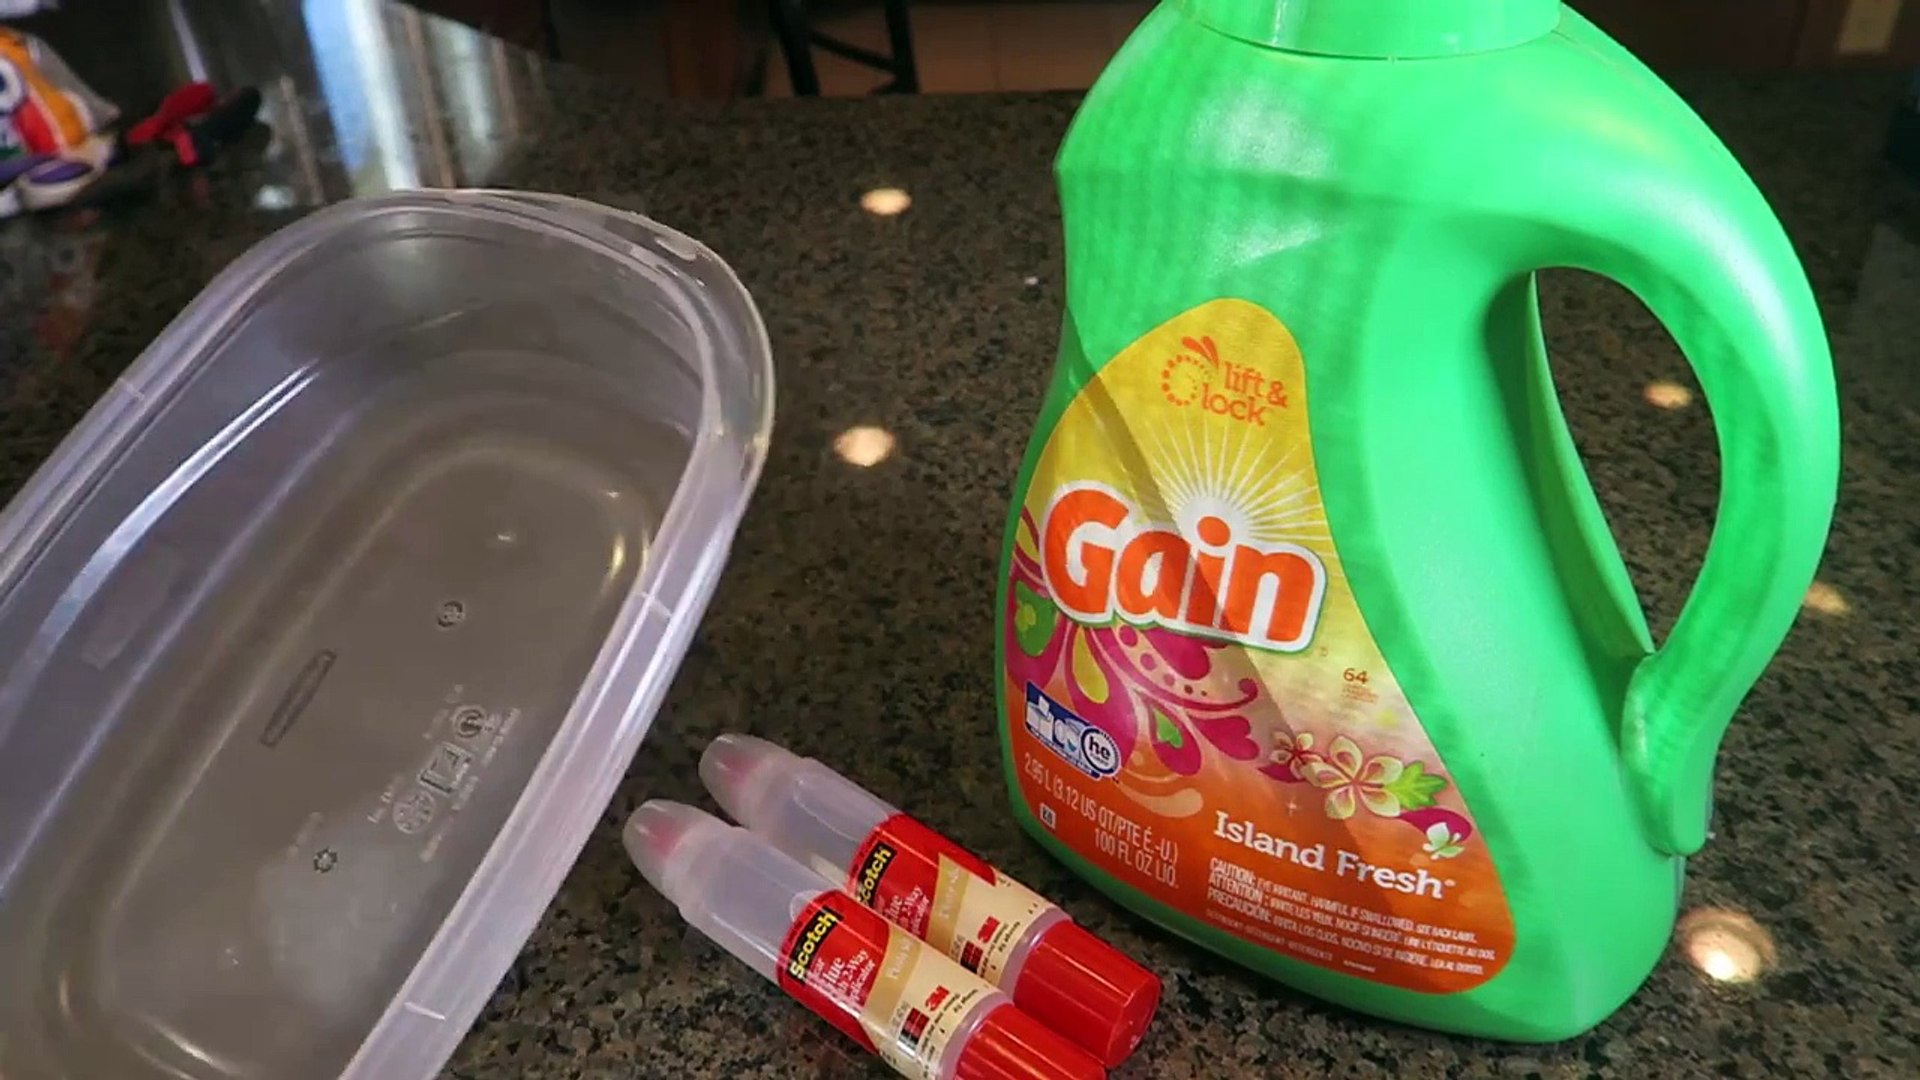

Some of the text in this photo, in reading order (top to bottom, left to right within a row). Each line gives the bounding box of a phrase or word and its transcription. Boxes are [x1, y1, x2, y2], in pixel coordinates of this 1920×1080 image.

[1201, 382, 1266, 426] lock
[1224, 361, 1288, 409] lift &
[1043, 488, 1315, 643] Gain
[1343, 667, 1369, 685] 64
[1088, 739, 1111, 761] he
[1044, 769, 1052, 792] L
[1080, 795, 1097, 822] US
[1094, 828, 1116, 856] 100
[1118, 841, 1133, 866] FL
[1135, 853, 1152, 877] OZ
[1213, 811, 1443, 900] Island Fresh
[884, 894, 903, 921] lue
[1208, 870, 1264, 905] ATTENTION
[789, 912, 838, 980] Scotch
[841, 949, 869, 981] 2-Way
[819, 956, 845, 988] lue
